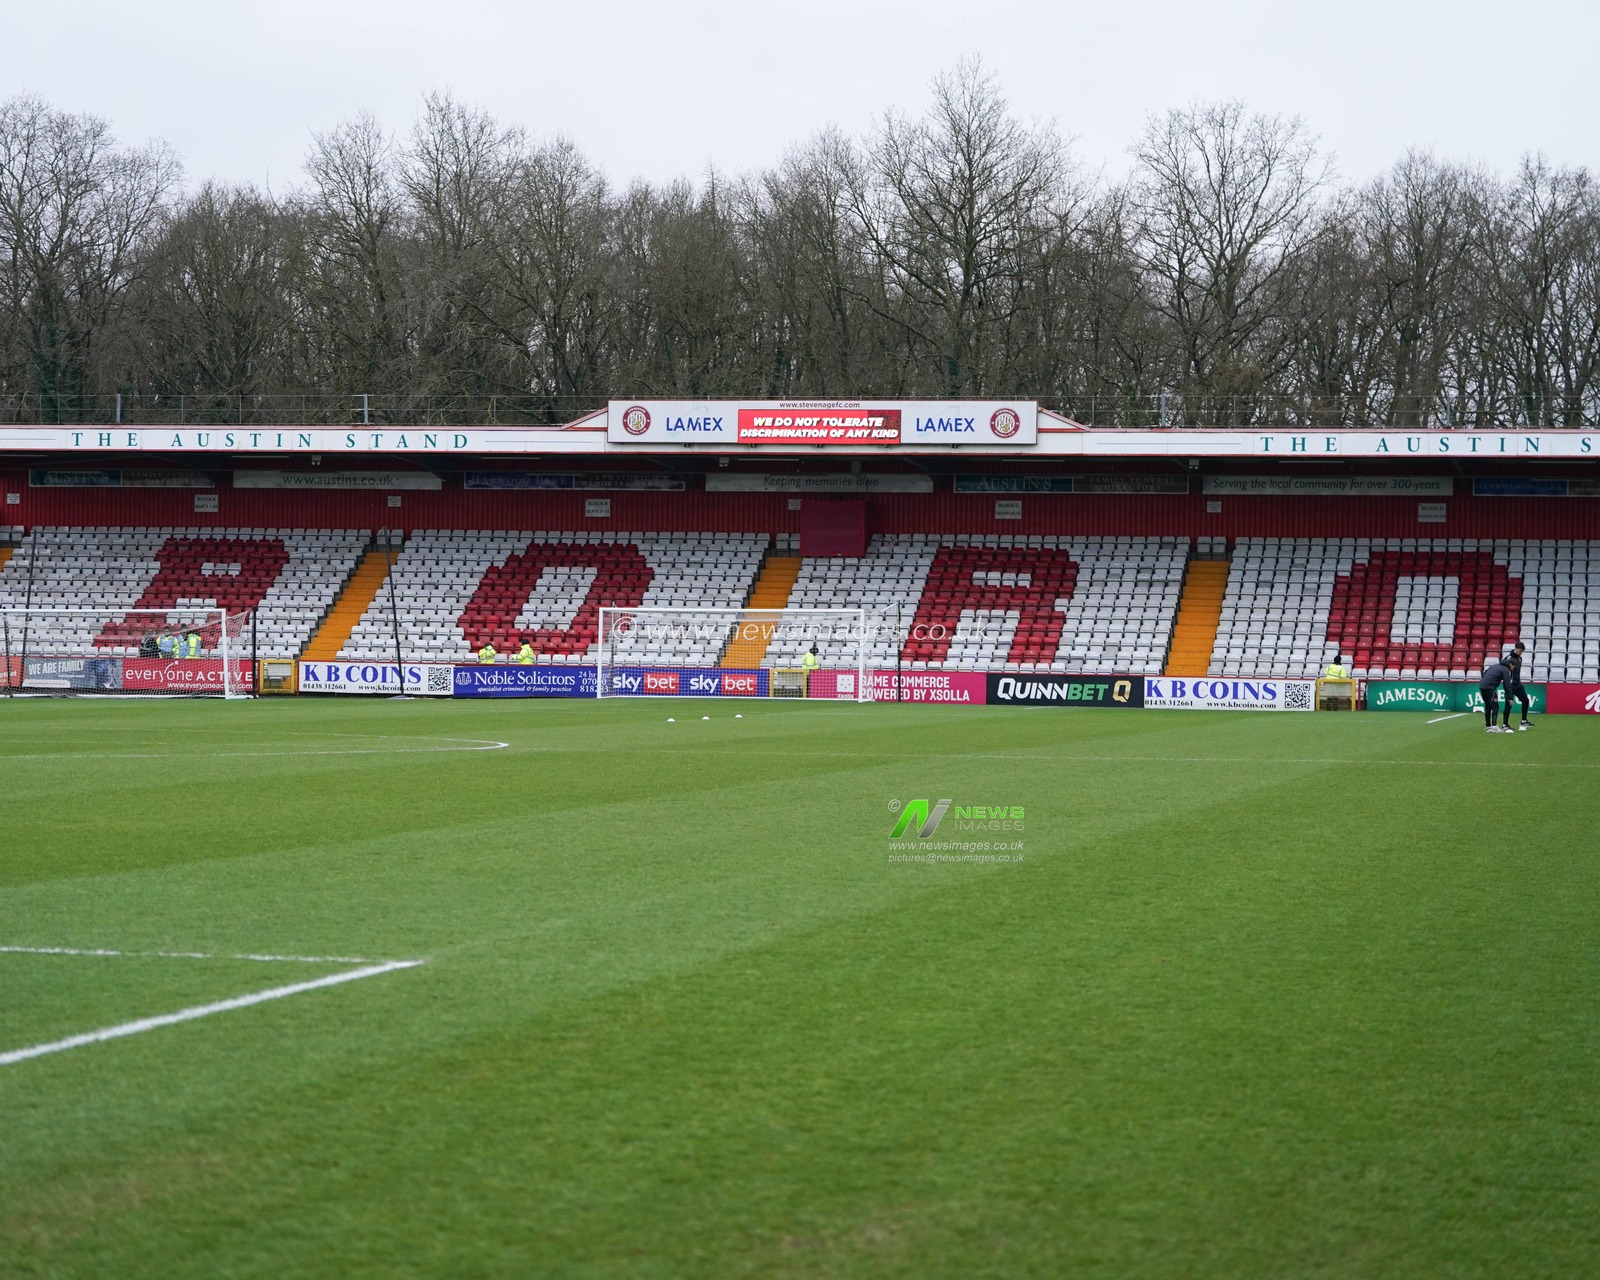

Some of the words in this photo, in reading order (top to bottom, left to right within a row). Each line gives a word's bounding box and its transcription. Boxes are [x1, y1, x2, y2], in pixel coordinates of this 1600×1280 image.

[666, 417, 723, 432] LAMEX
[753, 417, 774, 427] WE
[775, 417, 794, 427] DO
[794, 417, 821, 427] NOT
[822, 417, 884, 427] TOLERATE
[916, 417, 975, 432] LAMEX
[72, 432, 138, 447] THE
[171, 433, 312, 448] AUSTIN
[346, 433, 468, 449] STAND
[740, 429, 828, 438] DISCRIMINATION
[830, 429, 845, 438] OF
[846, 429, 872, 438] ANY
[872, 429, 898, 438] KIND
[1260, 436, 1337, 452] THE
[1376, 437, 1540, 453] AUSTIN
[282, 474, 394, 485] www.austins.co.uk
[763, 476, 801, 488] Keeping
[805, 477, 852, 486] memories
[977, 476, 1052, 490] AUSTIN'S
[1213, 478, 1248, 490] Serving
[1251, 478, 1266, 488] the
[1270, 479, 1292, 488] local
[1295, 479, 1347, 491] community
[1350, 479, 1364, 490] for
[1367, 481, 1387, 489] over
[28, 663, 41, 675] WE
[42, 661, 57, 674] ARE
[58, 659, 85, 673] FAMILY
[125, 663, 192, 682] everyone
[304, 664, 320, 682] K
[327, 665, 340, 682] B
[345, 665, 421, 684] COINS
[474, 671, 515, 685] Noble
[517, 671, 576, 686] Solicitors
[582, 677, 607, 685] 0700
[613, 673, 642, 691] sky
[647, 673, 675, 689] bet
[690, 674, 719, 693] sky
[725, 675, 754, 691] bet
[861, 676, 889, 687] GAME
[891, 676, 950, 688] COMMERCE
[532, 685, 550, 693] family
[861, 688, 911, 700] POWERED
[913, 689, 928, 700] BY
[929, 690, 970, 701] XSOLLA
[1112, 680, 1132, 702] Q
[1146, 680, 1164, 698] K
[1171, 680, 1186, 698] B
[1192, 681, 1277, 701] COINS
[1207, 700, 1277, 709] www.kbcoins.com
[1376, 688, 1446, 706] JAMESON
